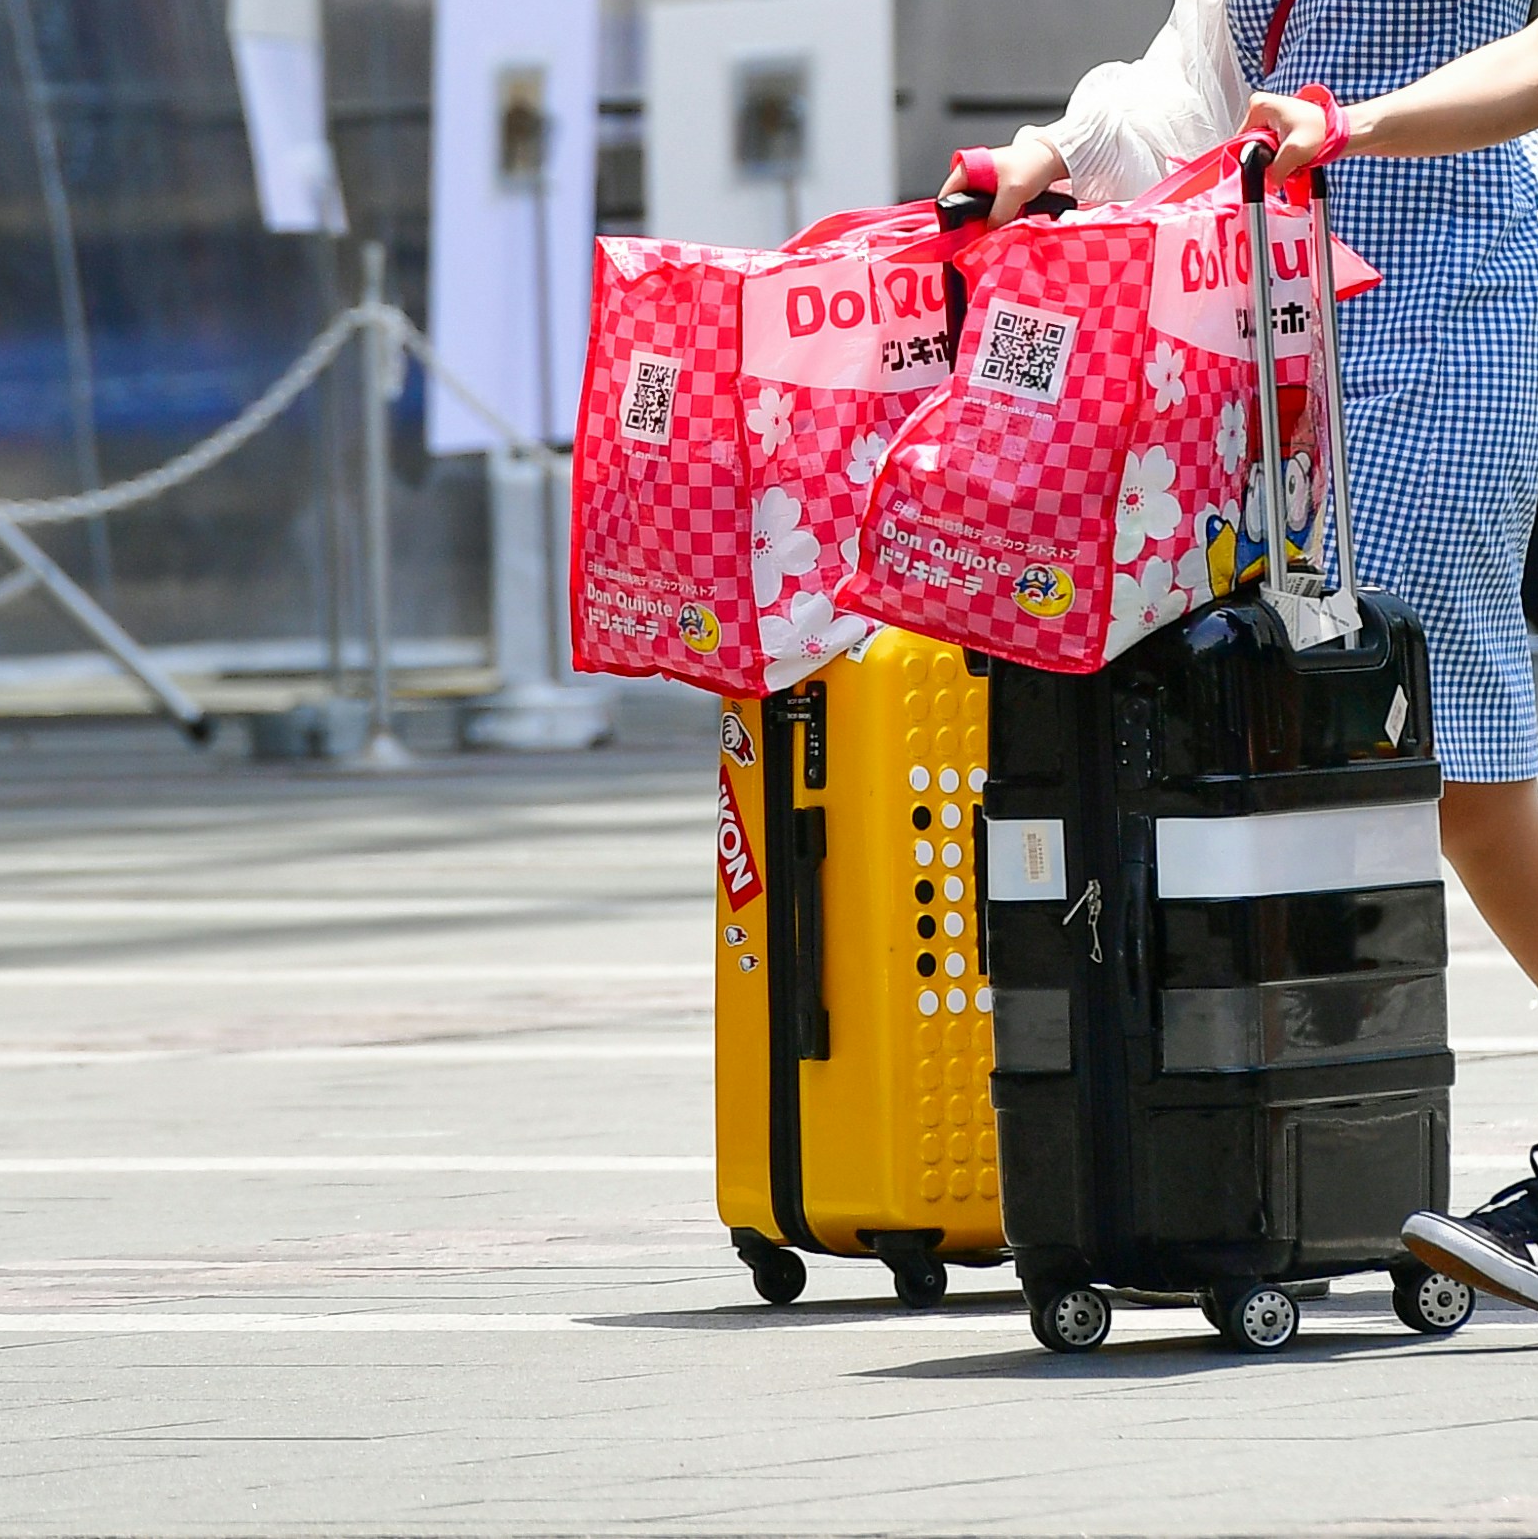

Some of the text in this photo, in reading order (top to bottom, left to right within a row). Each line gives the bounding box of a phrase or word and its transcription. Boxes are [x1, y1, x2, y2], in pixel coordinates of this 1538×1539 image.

[963, 395, 1053, 421] www.donki.com
[882, 520, 1012, 576] Don Quijote
[587, 582, 673, 618] Don Quijote
